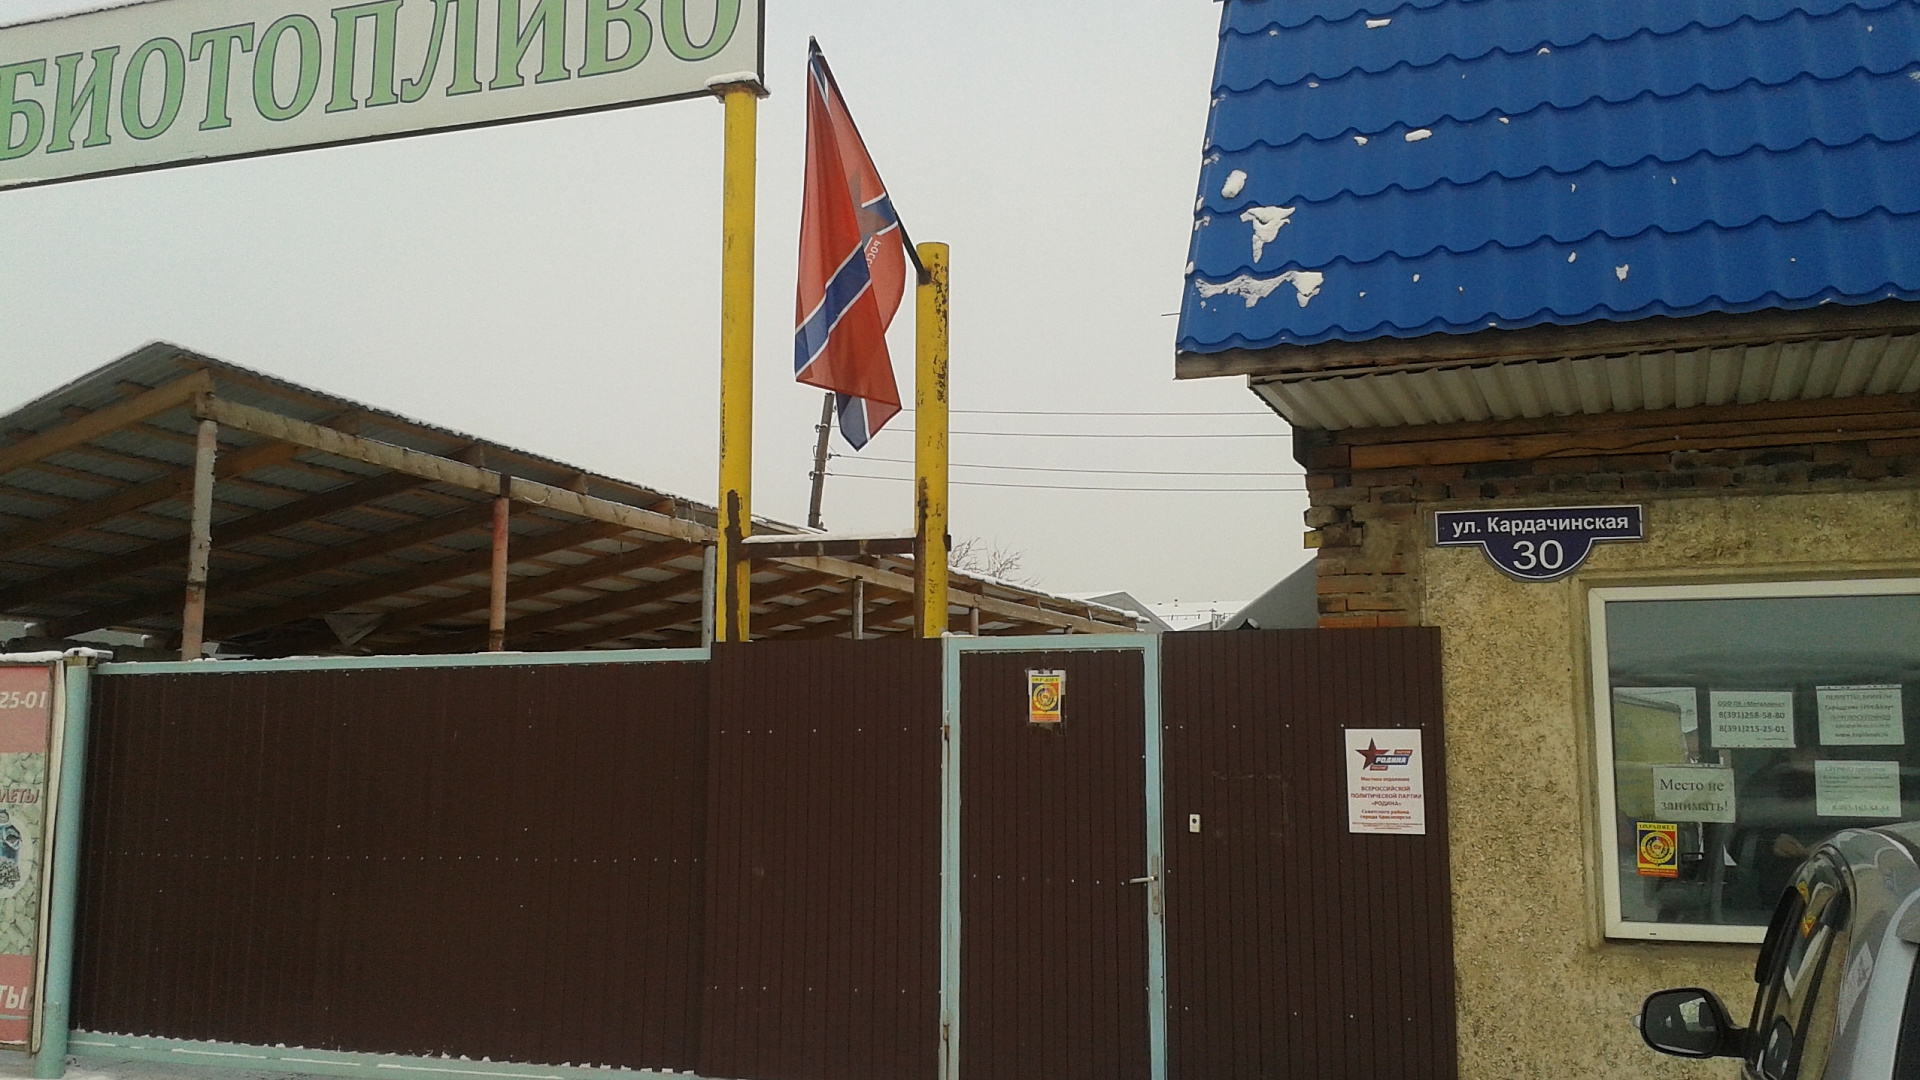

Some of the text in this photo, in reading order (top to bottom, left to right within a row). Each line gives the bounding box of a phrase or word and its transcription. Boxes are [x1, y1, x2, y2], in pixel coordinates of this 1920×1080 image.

[0, 0, 742, 162] БИОТОПЛИВО
[1452, 516, 1629, 538] ул. Кардачинская
[1513, 539, 1564, 570] 30
[1660, 778, 1725, 791] Место не
[1660, 800, 1729, 812] занимать!
